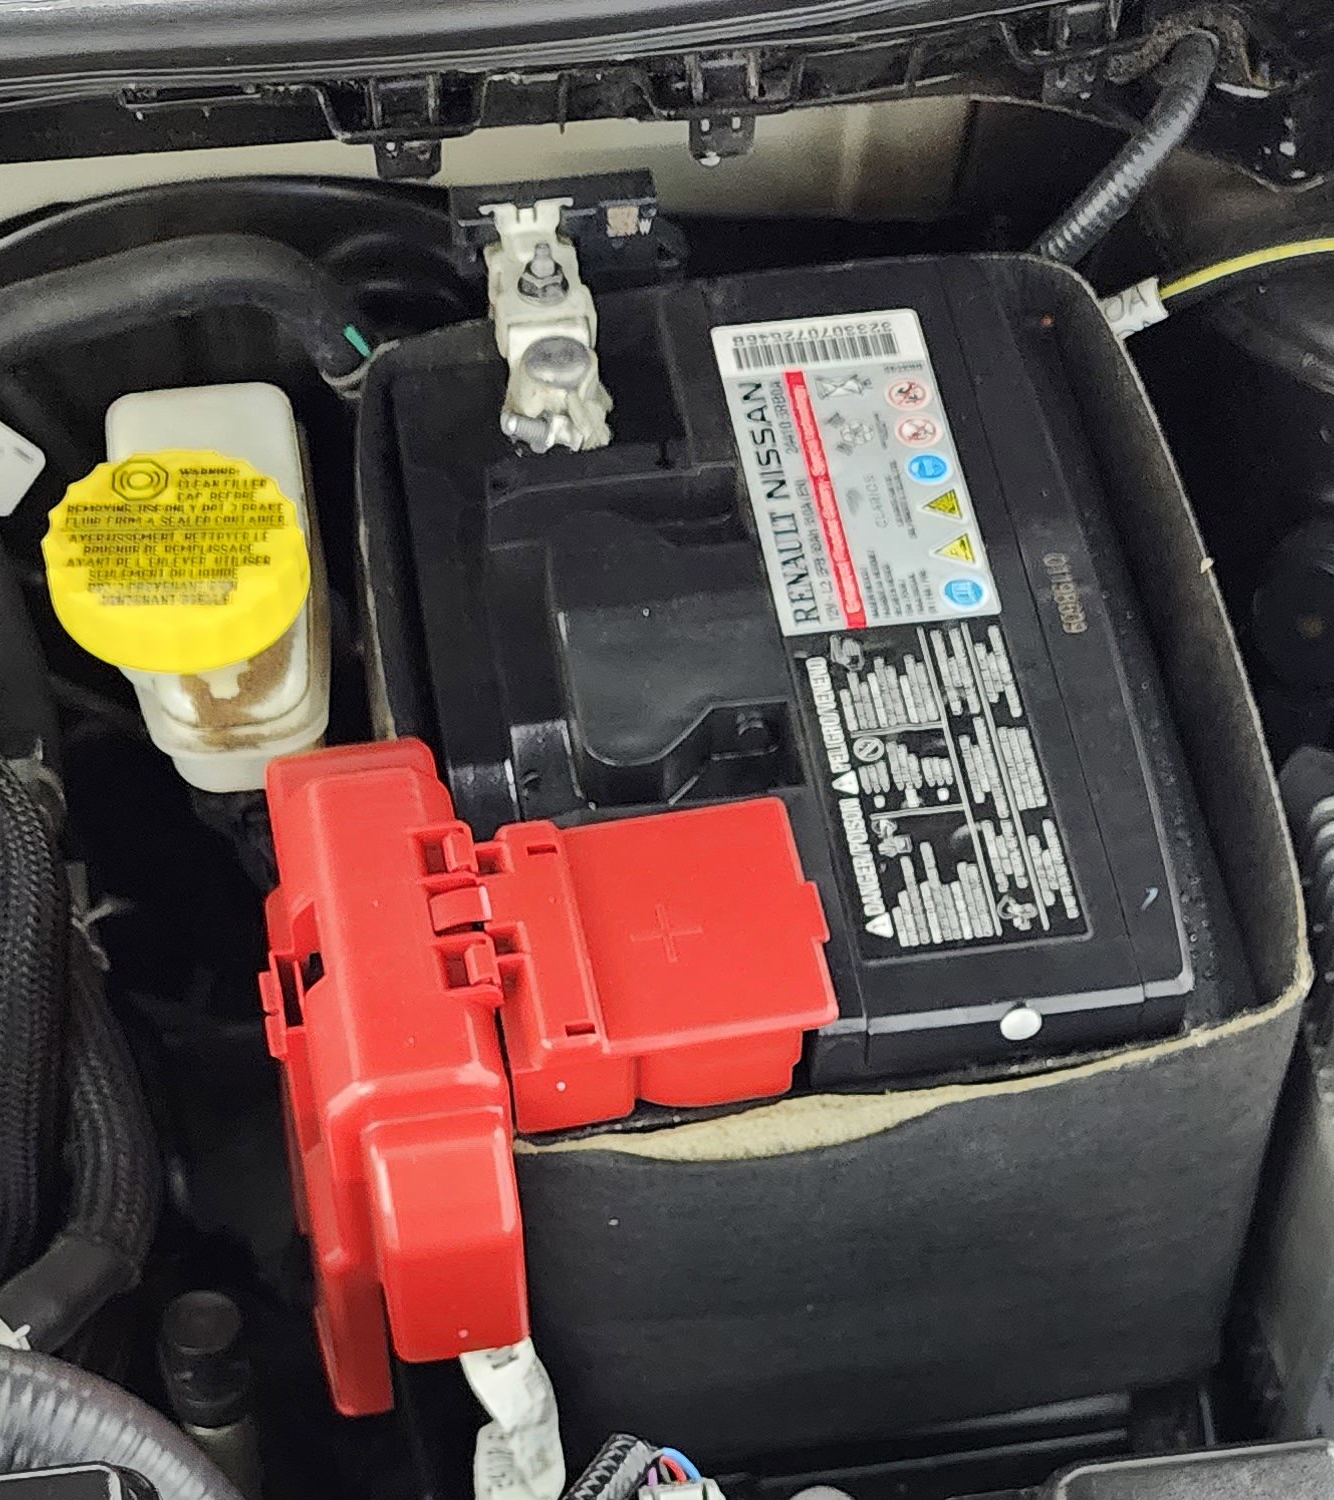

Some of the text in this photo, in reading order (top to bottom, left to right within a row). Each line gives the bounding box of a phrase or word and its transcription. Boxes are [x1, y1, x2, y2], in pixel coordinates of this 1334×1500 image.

[737, 377, 820, 628] RENAULT NISSAN
[804, 654, 852, 774] PELIGRO/VENENO
[837, 794, 886, 917] DANGER/POISON
